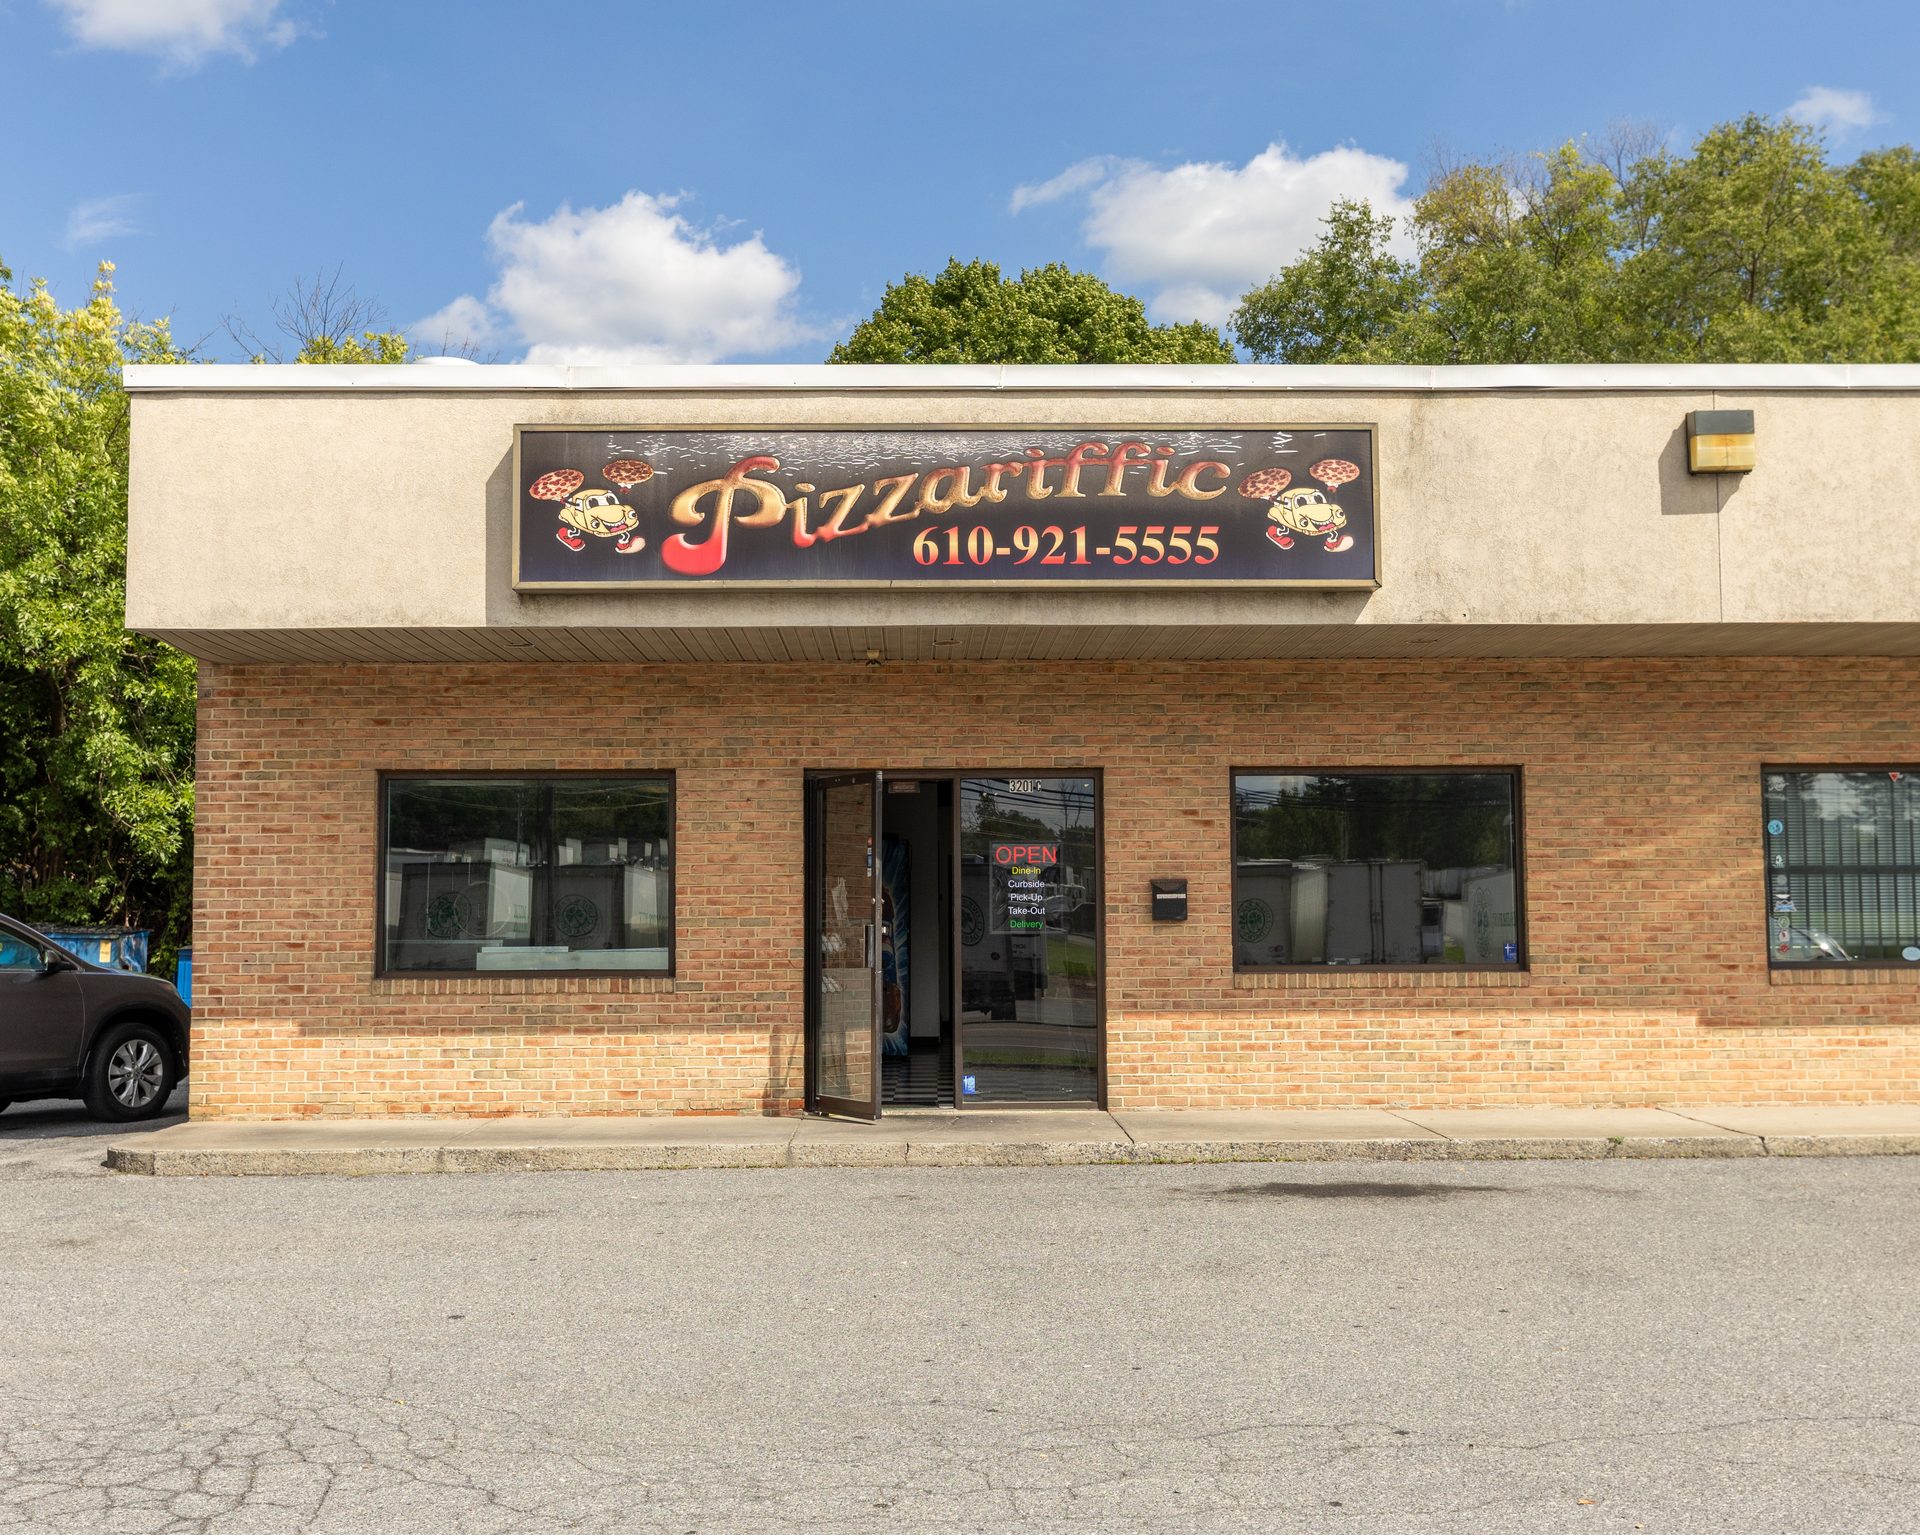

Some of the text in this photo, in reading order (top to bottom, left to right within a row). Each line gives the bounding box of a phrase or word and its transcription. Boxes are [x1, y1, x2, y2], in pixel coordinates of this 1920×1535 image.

[661, 441, 1231, 576] Pizzariffic
[913, 525, 1220, 565] 610-921-5555
[995, 846, 1057, 864] OPEN
[1012, 866, 1041, 875] Dine-In
[1008, 880, 1045, 888] Curbside
[1010, 893, 1043, 903] Pick-Up
[1008, 907, 1045, 915] Take-Out
[1010, 920, 1043, 929] Delivery
